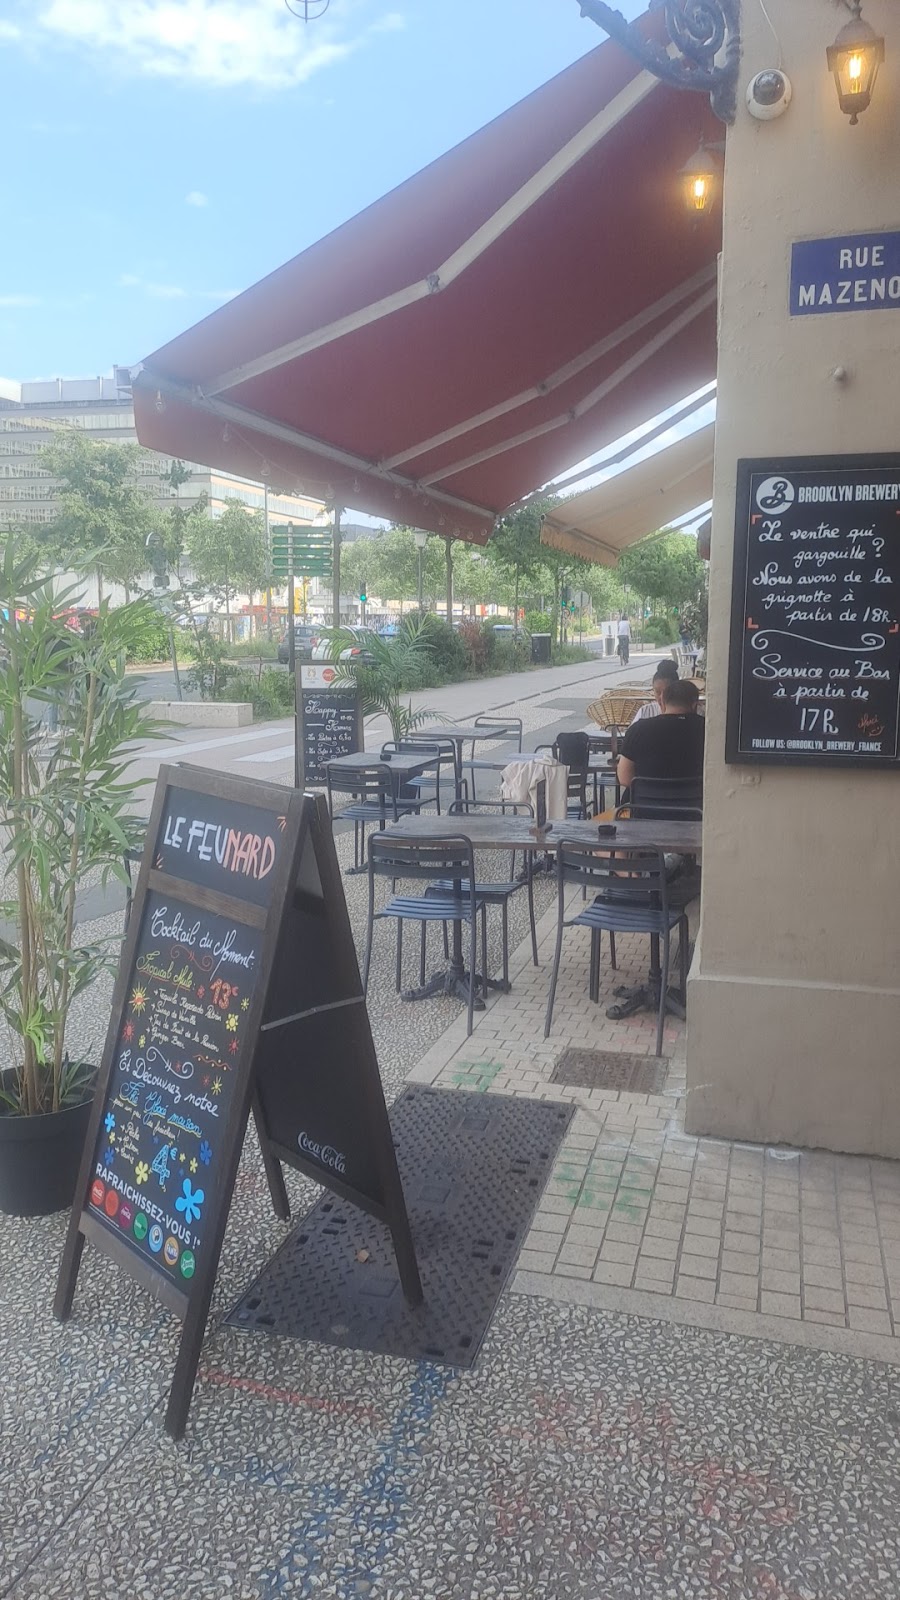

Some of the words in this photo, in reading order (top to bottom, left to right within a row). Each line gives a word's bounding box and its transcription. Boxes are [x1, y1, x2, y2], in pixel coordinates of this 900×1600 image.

[840, 246, 884, 269] RUE
[798, 276, 900, 306] MAZENO
[798, 485, 852, 502] BROOKLYN
[855, 483, 900, 500] BREWER
[758, 520, 784, 542] Le
[790, 522, 840, 540] ventre
[846, 524, 876, 543] qui
[793, 544, 866, 568] gargouille
[752, 562, 792, 586] Nous
[797, 573, 837, 584] avons
[844, 570, 862, 583] de
[870, 568, 893, 584] la
[761, 590, 832, 610] grignotte
[840, 588, 855, 602] à
[786, 607, 833, 626] partir
[840, 608, 858, 622] de
[752, 653, 824, 679] Service
[829, 669, 851, 678] au
[854, 660, 890, 680] Bar
[773, 682, 788, 698] à
[791, 683, 846, 705] partir
[851, 686, 869, 700] de
[752, 738, 776, 748] FOLLOW
[776, 740, 786, 748] US:
[786, 740, 882, 752] @BROOKLYN_BREWERY_FRANCE
[164, 816, 186, 848] LE
[186, 820, 276, 880] FEUNARD
[151, 906, 200, 946] Cocktail
[200, 932, 214, 948] du
[132, 1058, 182, 1104] Découvrez
[184, 1093, 220, 1118] notre
[96, 1162, 192, 1244] RAFRAICHISSEZ-VOUS
